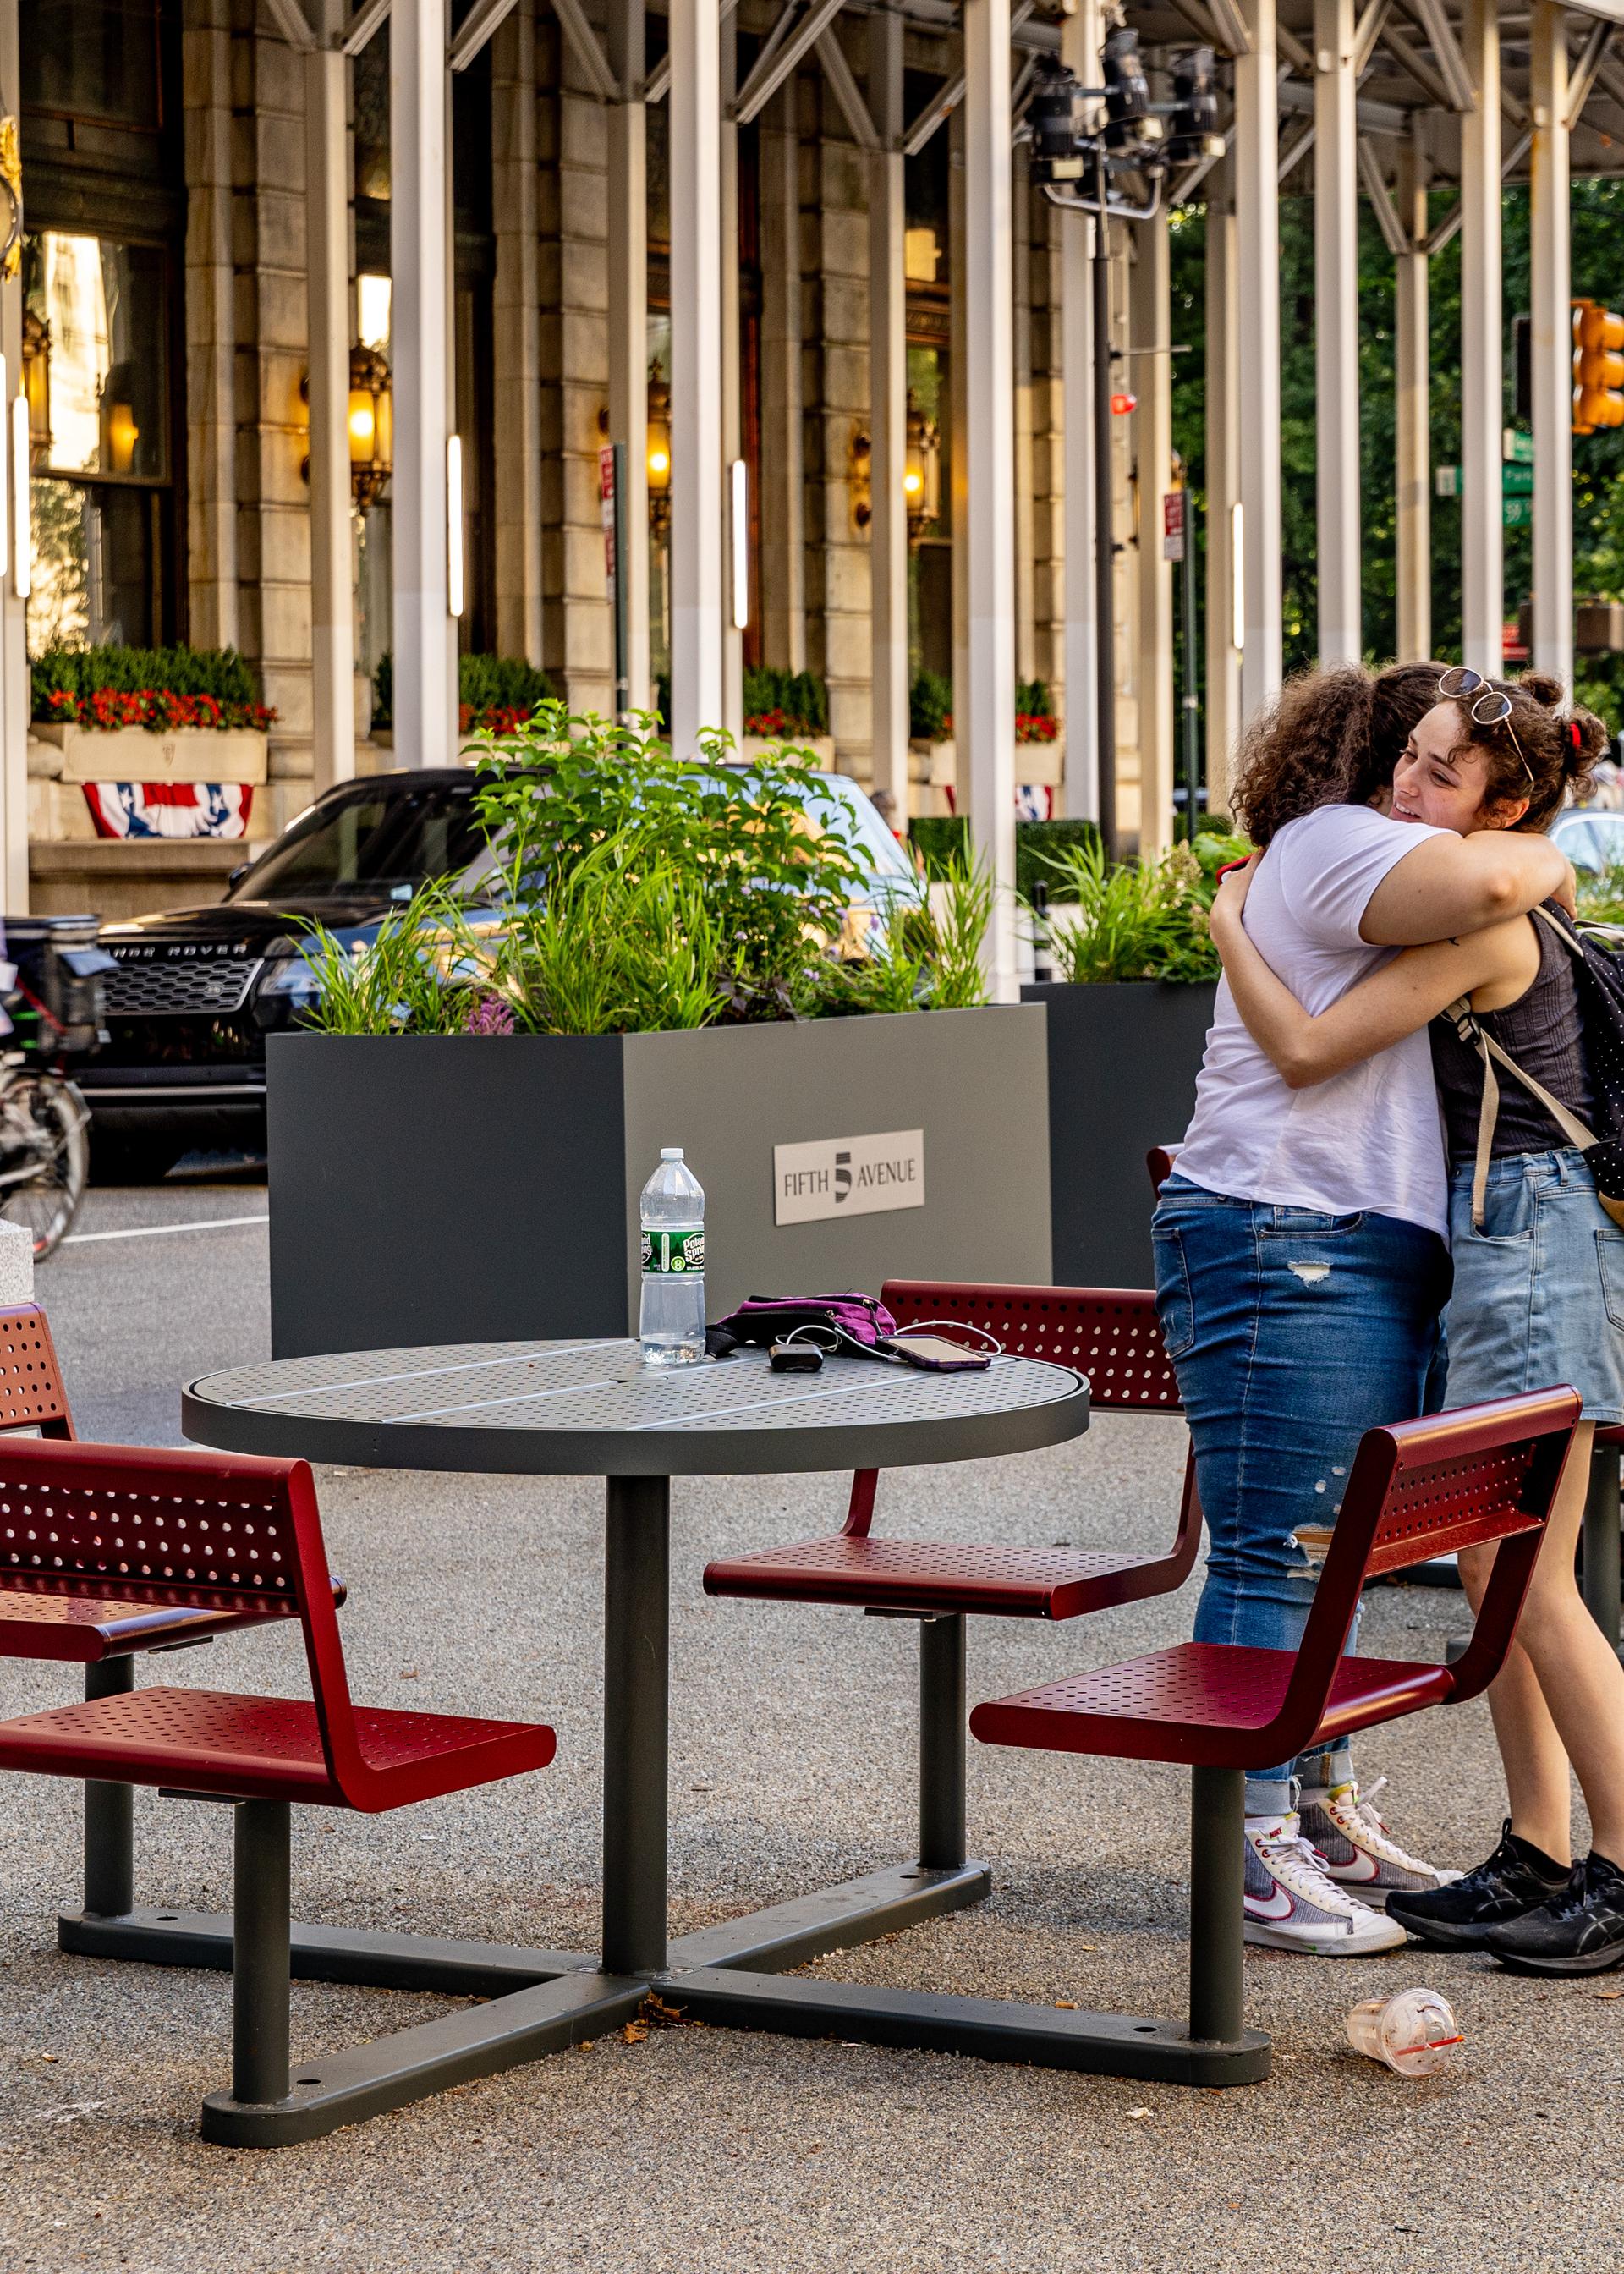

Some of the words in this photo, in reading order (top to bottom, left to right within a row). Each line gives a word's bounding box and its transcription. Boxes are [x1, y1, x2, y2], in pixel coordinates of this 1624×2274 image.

[105, 947, 155, 958] NGE
[167, 943, 247, 957] ROVER
[784, 1168, 829, 1197] FIFTH
[834, 1151, 853, 1204] 5
[858, 1157, 917, 1188] AVENUE
[683, 1237, 705, 1252] Pola
[684, 1244, 705, 1262] Spri
